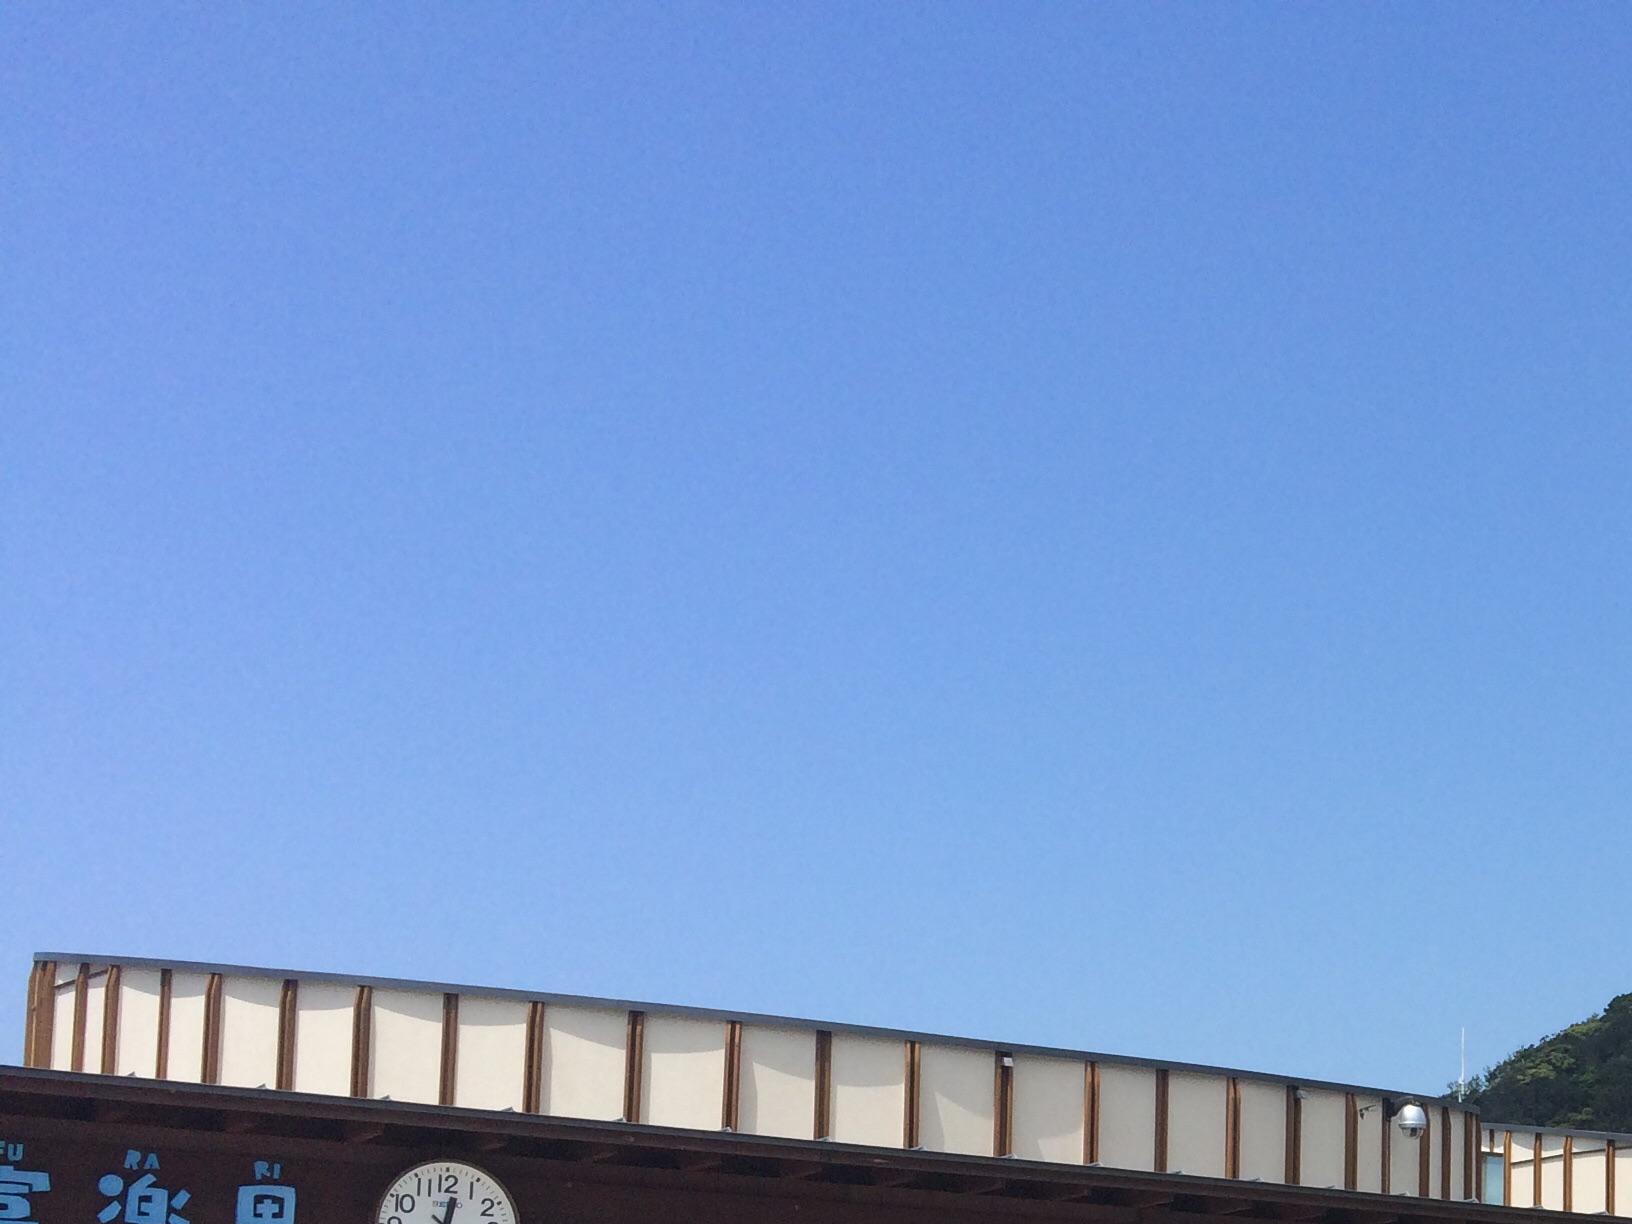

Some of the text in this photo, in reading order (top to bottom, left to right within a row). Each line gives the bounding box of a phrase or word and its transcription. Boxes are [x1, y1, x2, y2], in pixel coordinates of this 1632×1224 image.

[124, 1150, 160, 1170] RA
[254, 1161, 281, 1180] RI
[417, 1178, 432, 1197] 11
[438, 1174, 458, 1194] 12
[469, 1181, 475, 1200] 1
[395, 1194, 415, 1213] 10
[480, 1198, 494, 1217] 2
